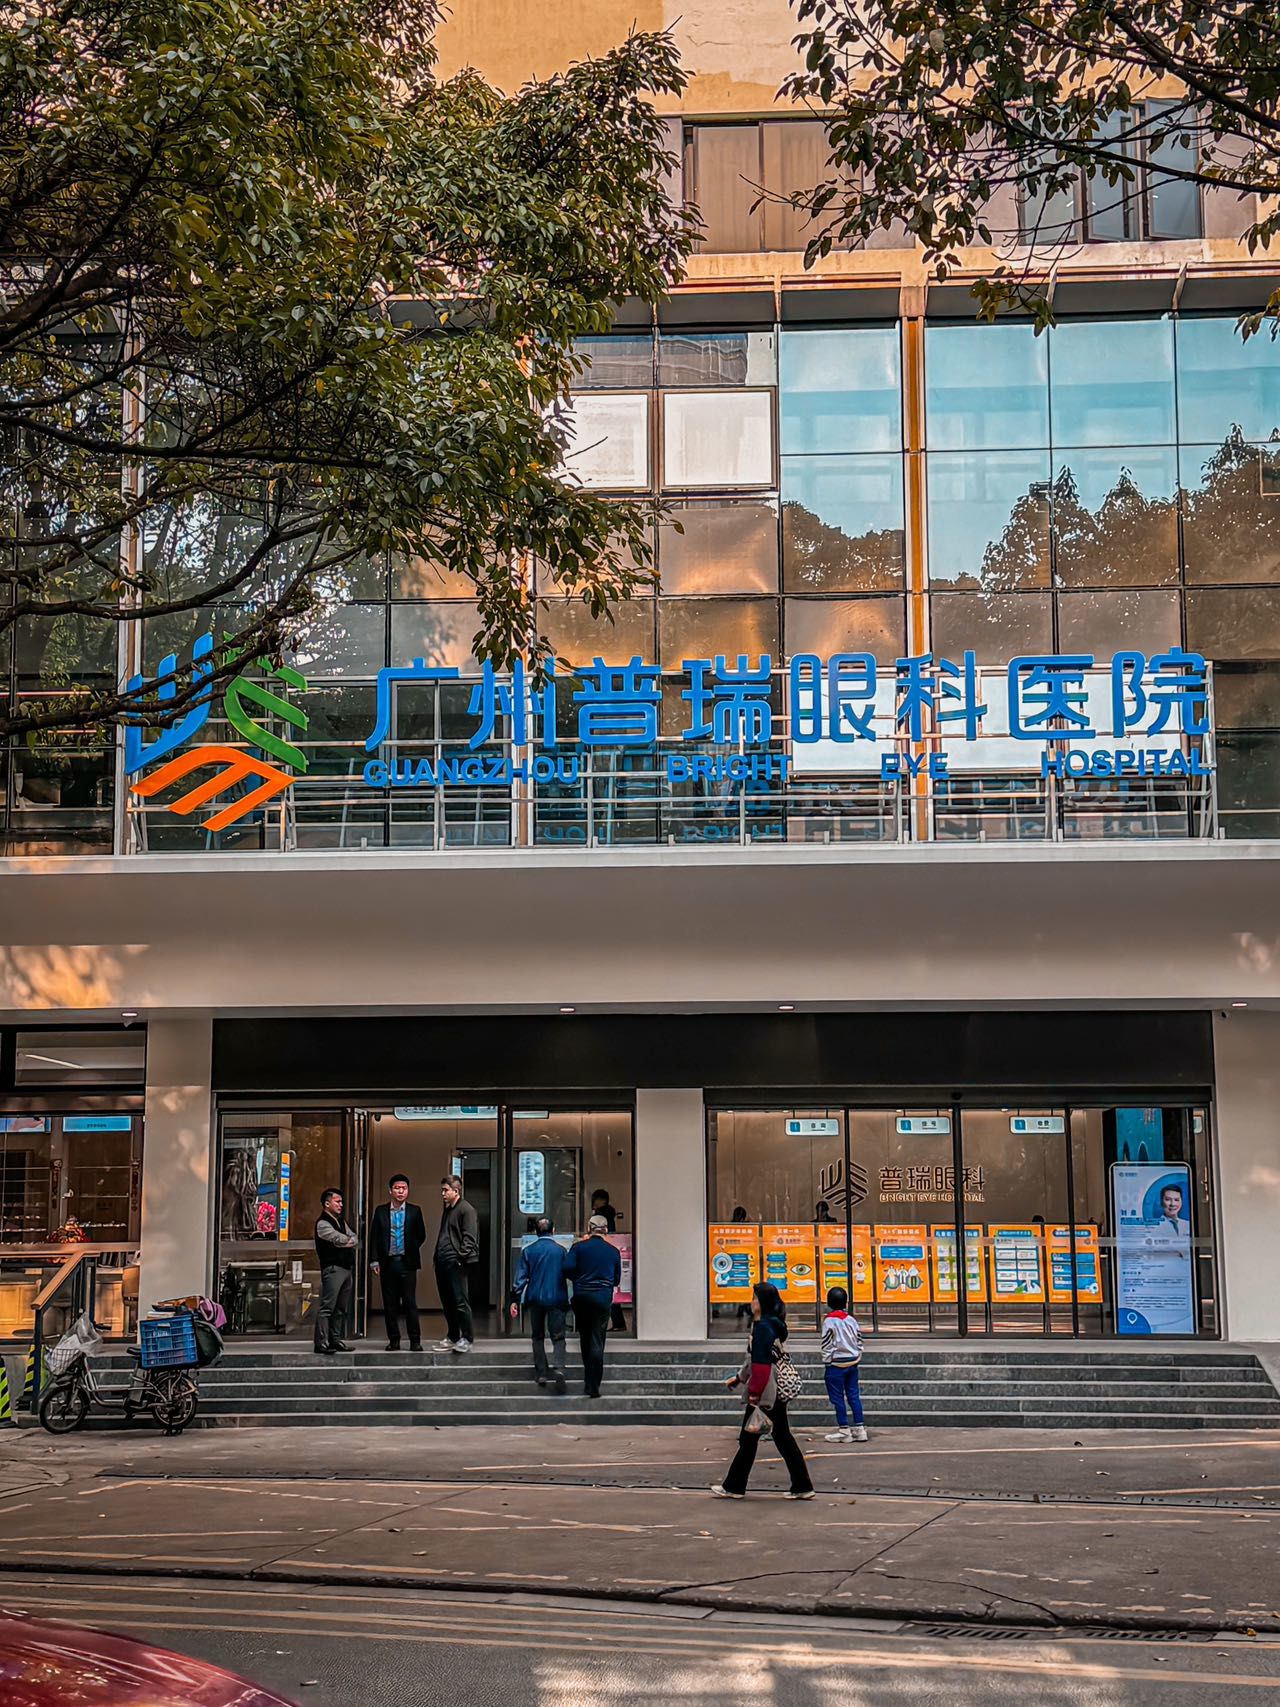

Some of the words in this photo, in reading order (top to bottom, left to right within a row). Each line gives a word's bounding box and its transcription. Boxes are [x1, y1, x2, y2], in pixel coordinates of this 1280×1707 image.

[365, 645, 1209, 752] 广州普瑞眼科医院
[363, 756, 579, 787] GUANGZHOU
[667, 754, 792, 783] BRIGHT
[881, 752, 950, 780] EYE
[1041, 748, 1212, 778] HOSPITAL
[880, 1166, 985, 1191] 普瑞眼科
